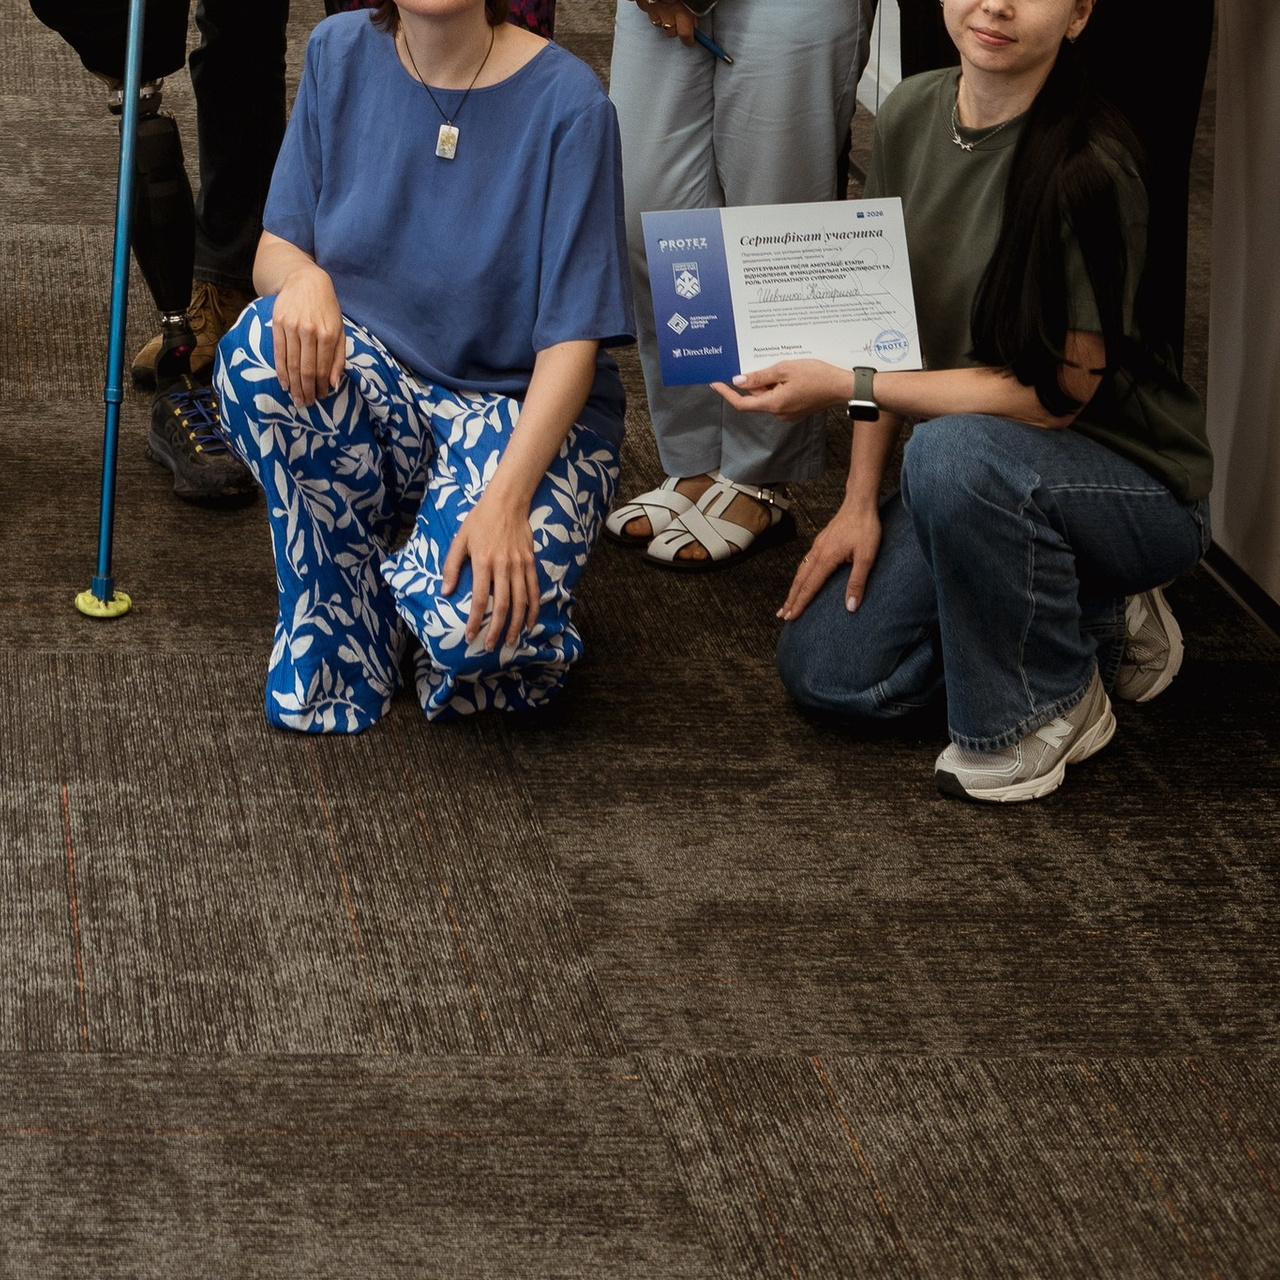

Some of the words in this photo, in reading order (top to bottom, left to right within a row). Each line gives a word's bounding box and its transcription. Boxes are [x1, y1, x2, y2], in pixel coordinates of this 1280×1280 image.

[659, 237, 706, 249] PROTEZ
[740, 232, 820, 246] Сертифікат
[824, 229, 882, 242] учасника
[682, 348, 703, 356] Direct
[703, 345, 722, 354] Relief
